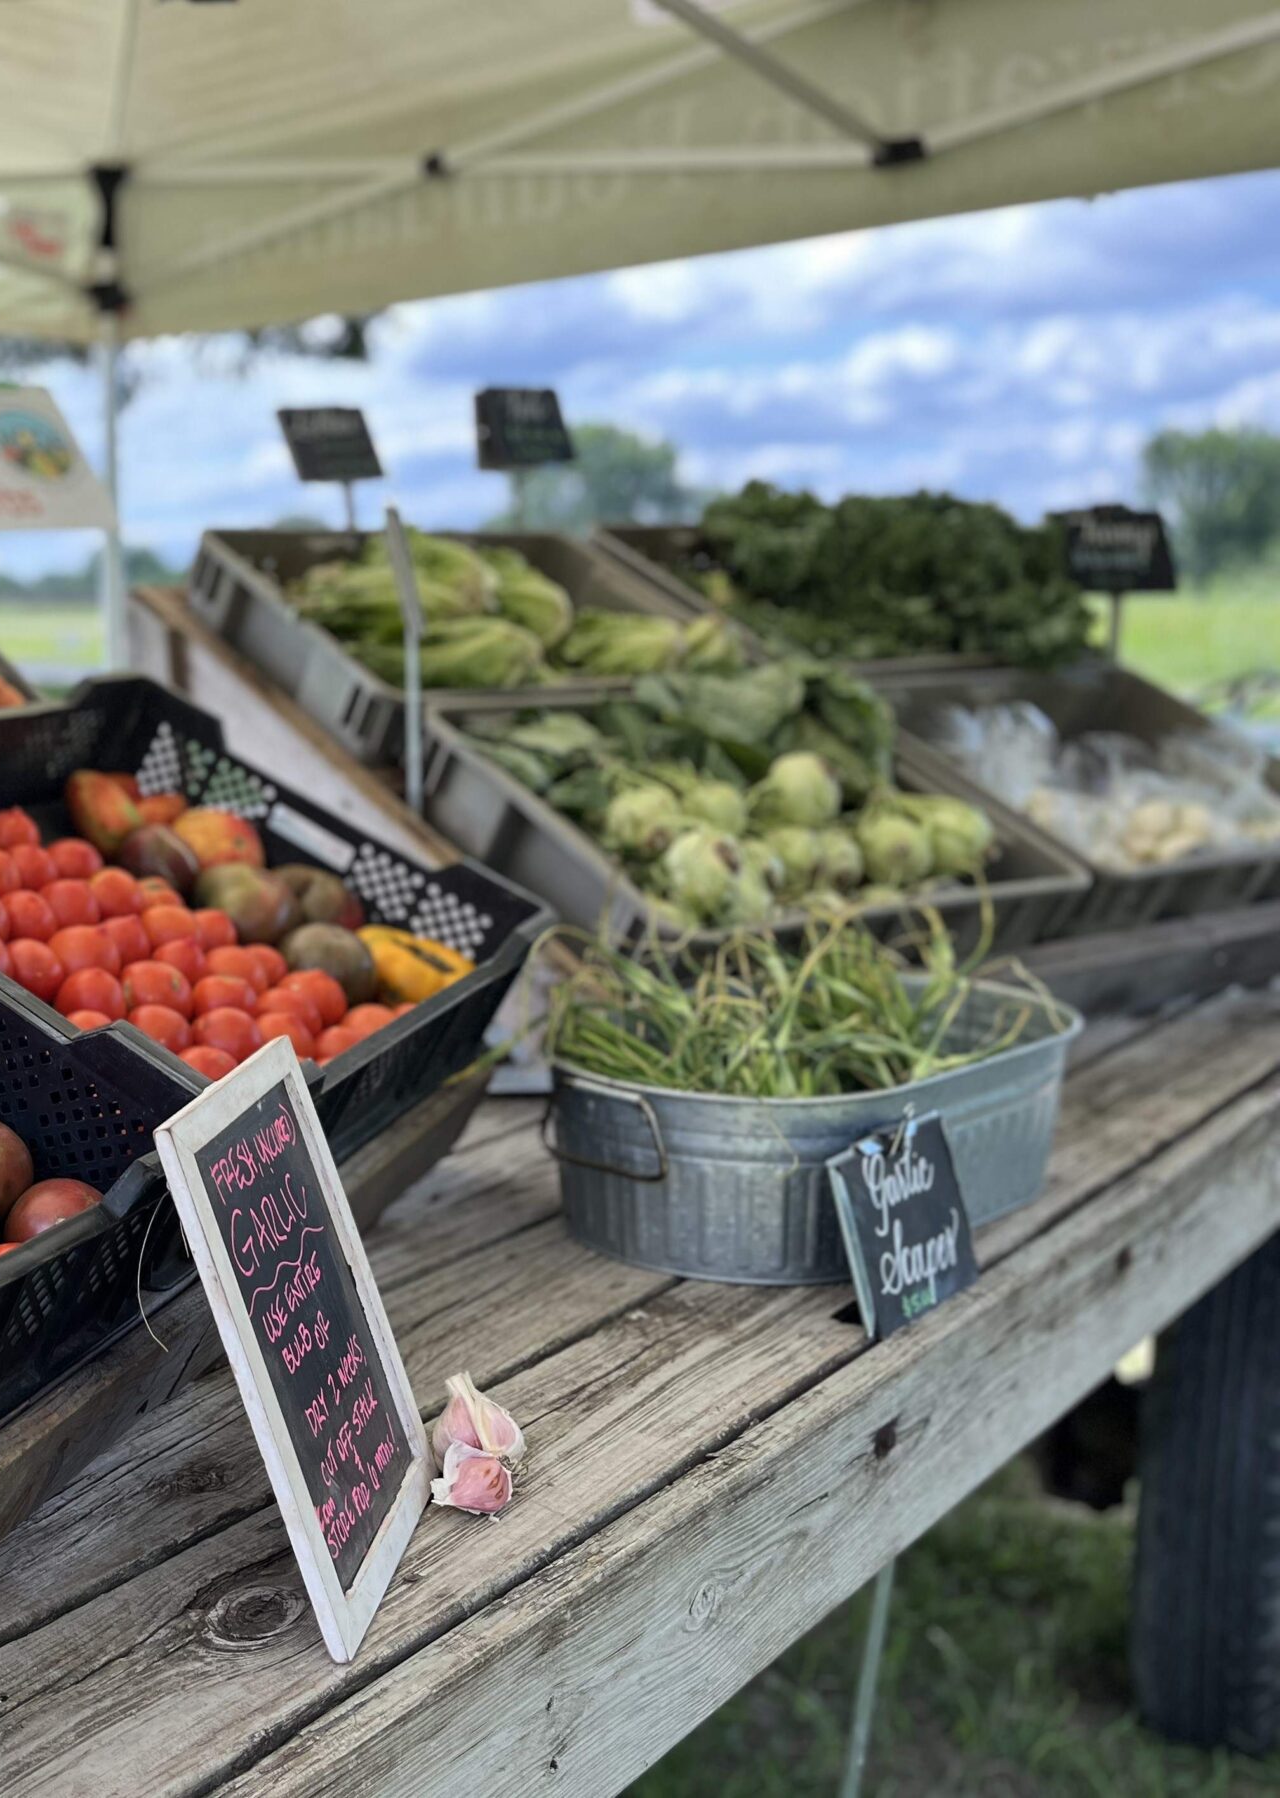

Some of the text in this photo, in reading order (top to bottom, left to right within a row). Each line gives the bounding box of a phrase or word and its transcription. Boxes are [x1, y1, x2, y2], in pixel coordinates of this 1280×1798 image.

[231, 1173, 307, 1277] GARLIC
[861, 1134, 934, 1238] Garlic
[262, 1250, 321, 1343] USE ENTIRE
[879, 1207, 959, 1305] Scapes
[282, 1310, 330, 1375] BULB OR
[305, 1386, 329, 1438] DRY
[327, 1373, 341, 1406] 2
[320, 1437, 339, 1487] CUT
[336, 1420, 353, 1462] OFF
[352, 1377, 378, 1436] STALK
[327, 1494, 356, 1559] STORE
[352, 1481, 371, 1518] FOR
